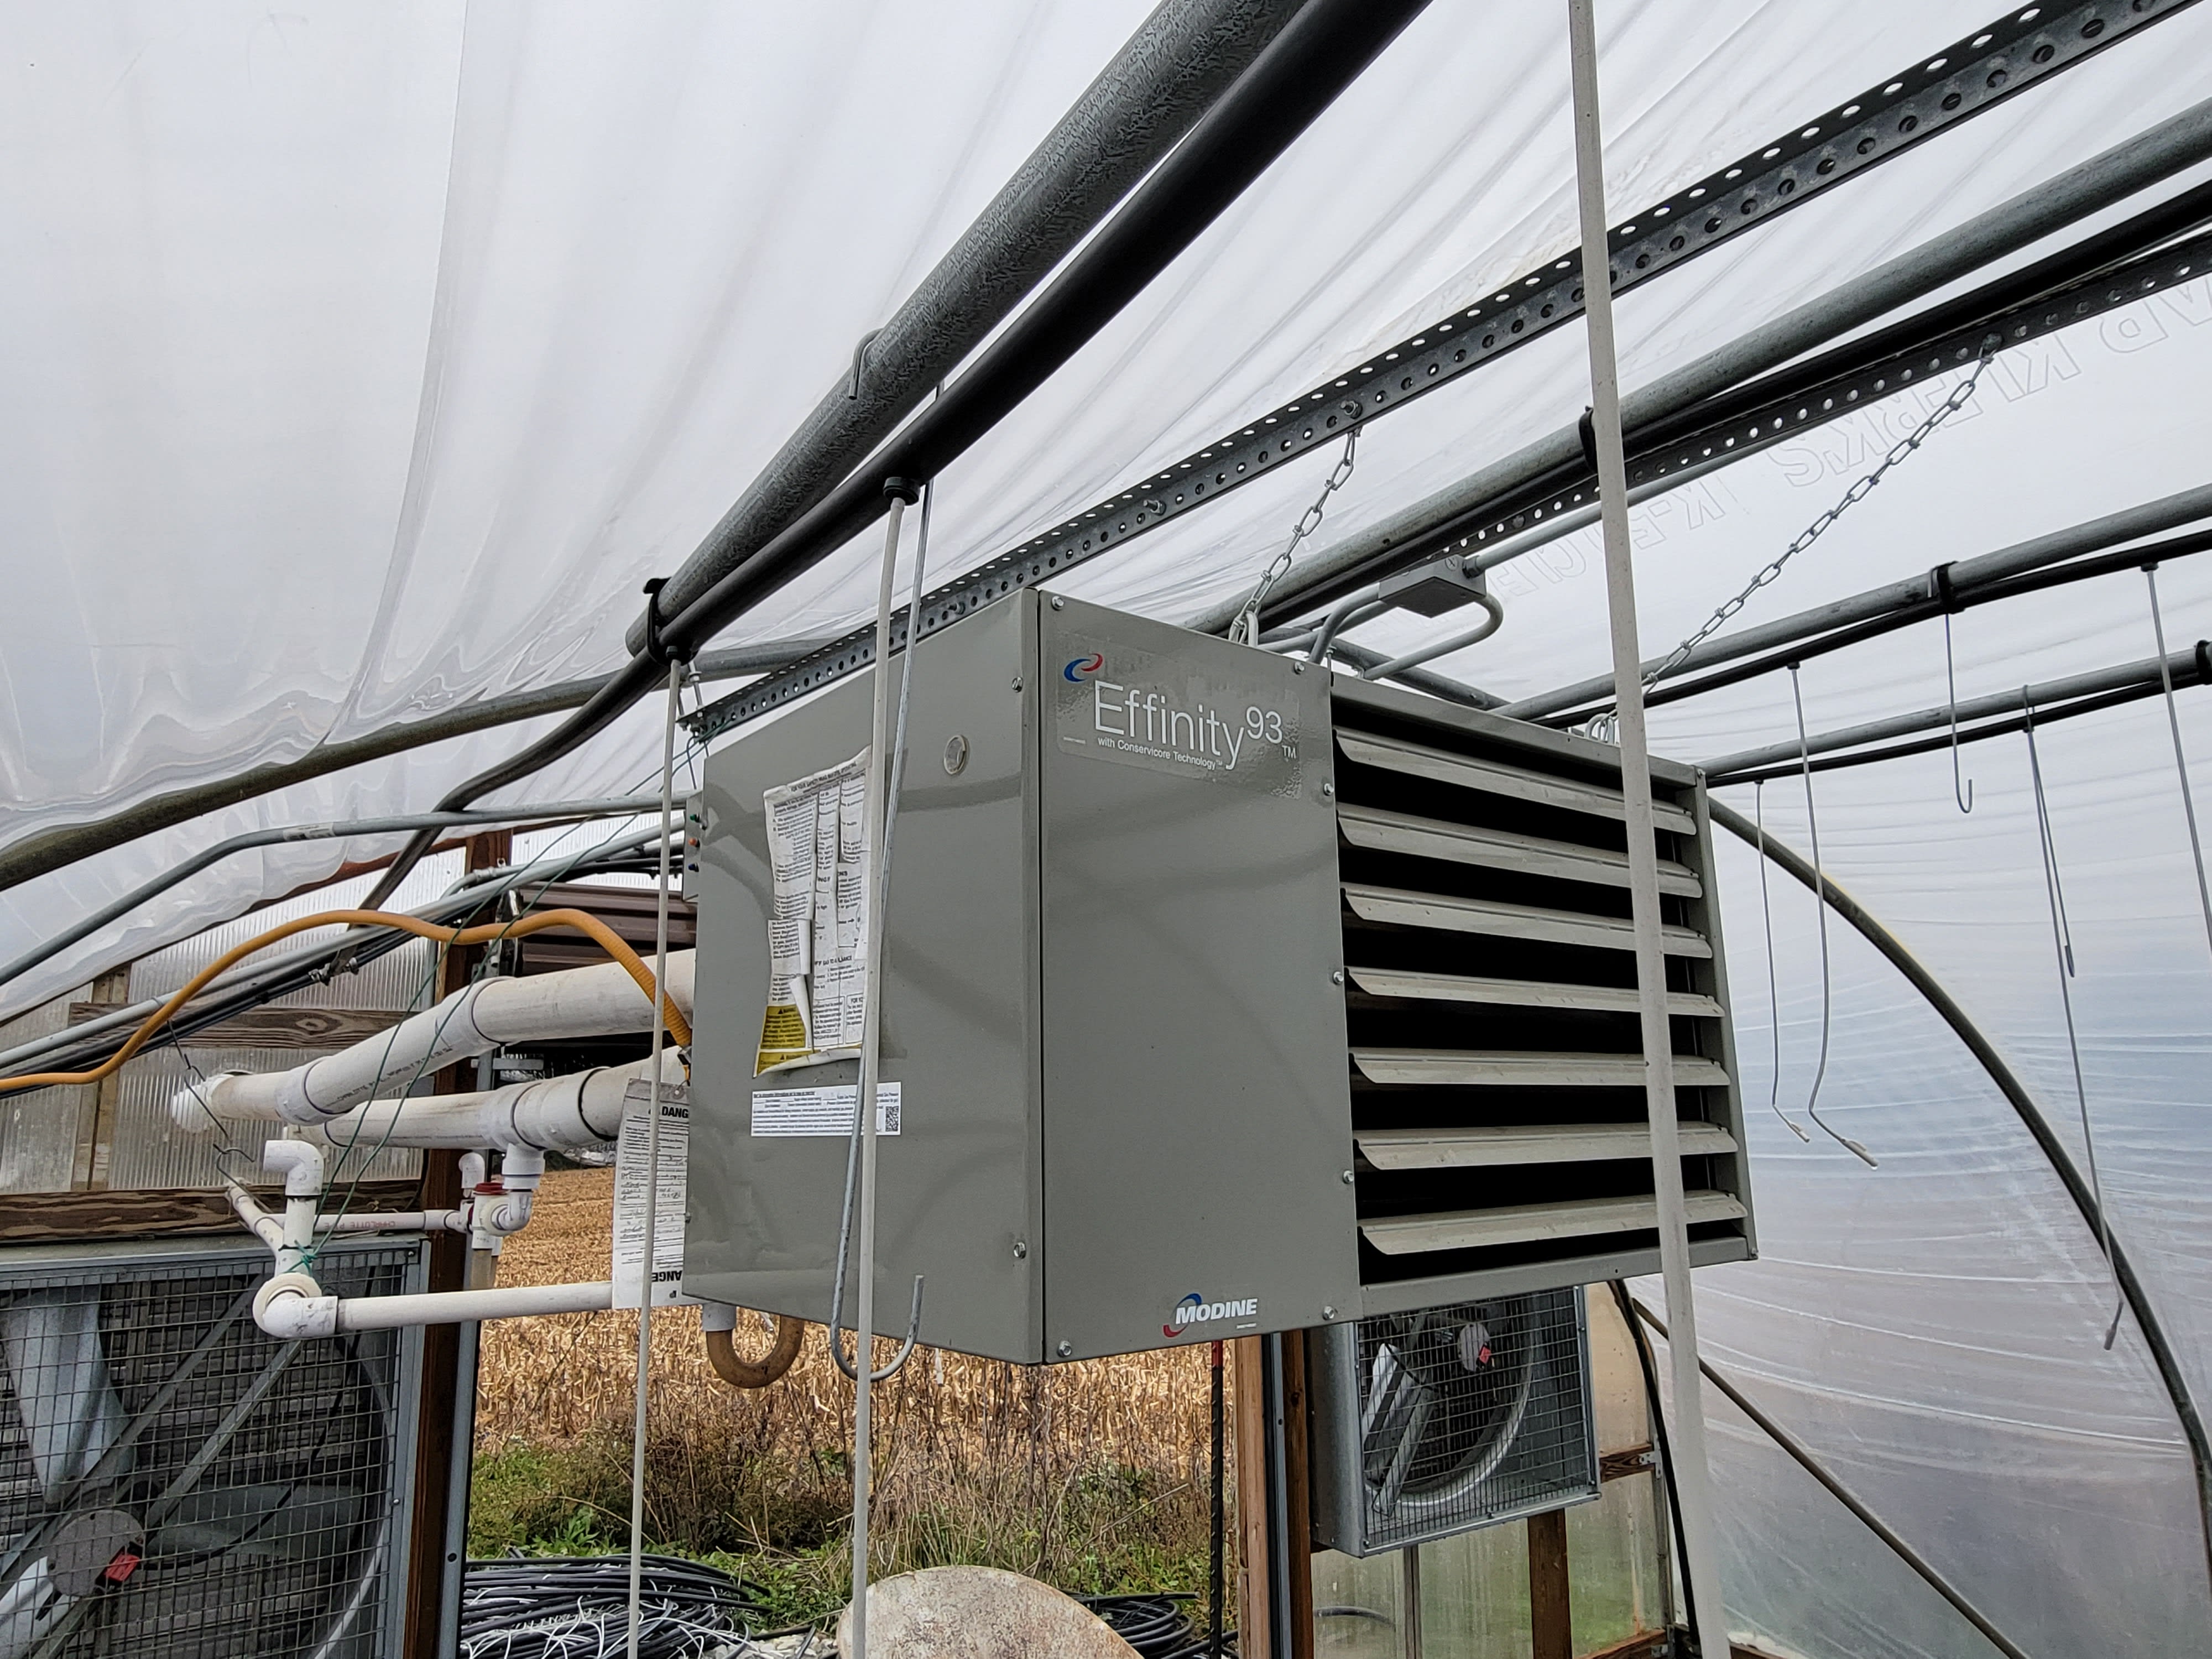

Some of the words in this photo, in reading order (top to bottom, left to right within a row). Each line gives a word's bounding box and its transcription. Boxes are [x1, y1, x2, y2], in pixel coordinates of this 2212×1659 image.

[1094, 680, 1244, 770] Effinity
[1097, 737, 1115, 749] with
[1117, 740, 1171, 760] Conservicore
[661, 1105, 689, 1119] DANG
[1175, 1298, 1258, 1324] MODINE
